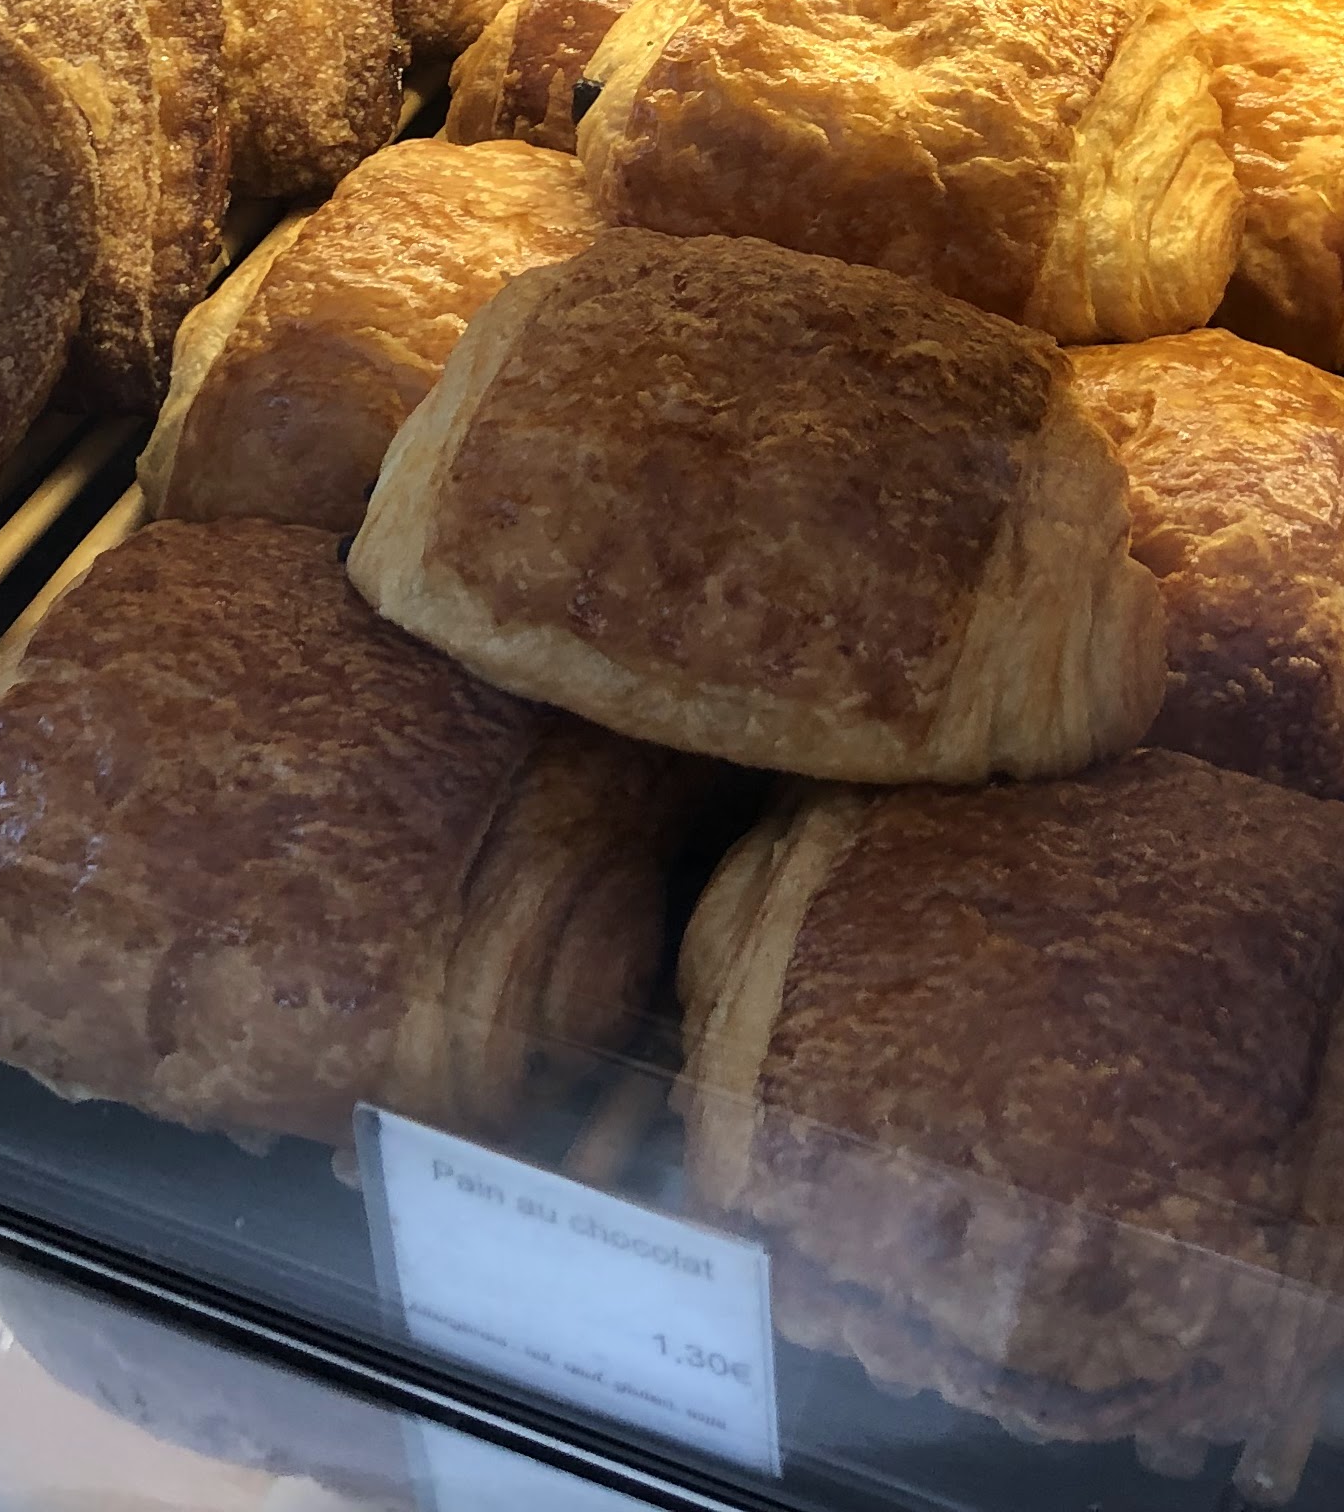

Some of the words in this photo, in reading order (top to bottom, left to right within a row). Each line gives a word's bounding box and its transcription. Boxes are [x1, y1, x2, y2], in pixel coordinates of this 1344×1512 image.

[432, 1158, 505, 1206] Pain
[516, 1196, 558, 1225] au
[569, 1213, 714, 1281] chocolat
